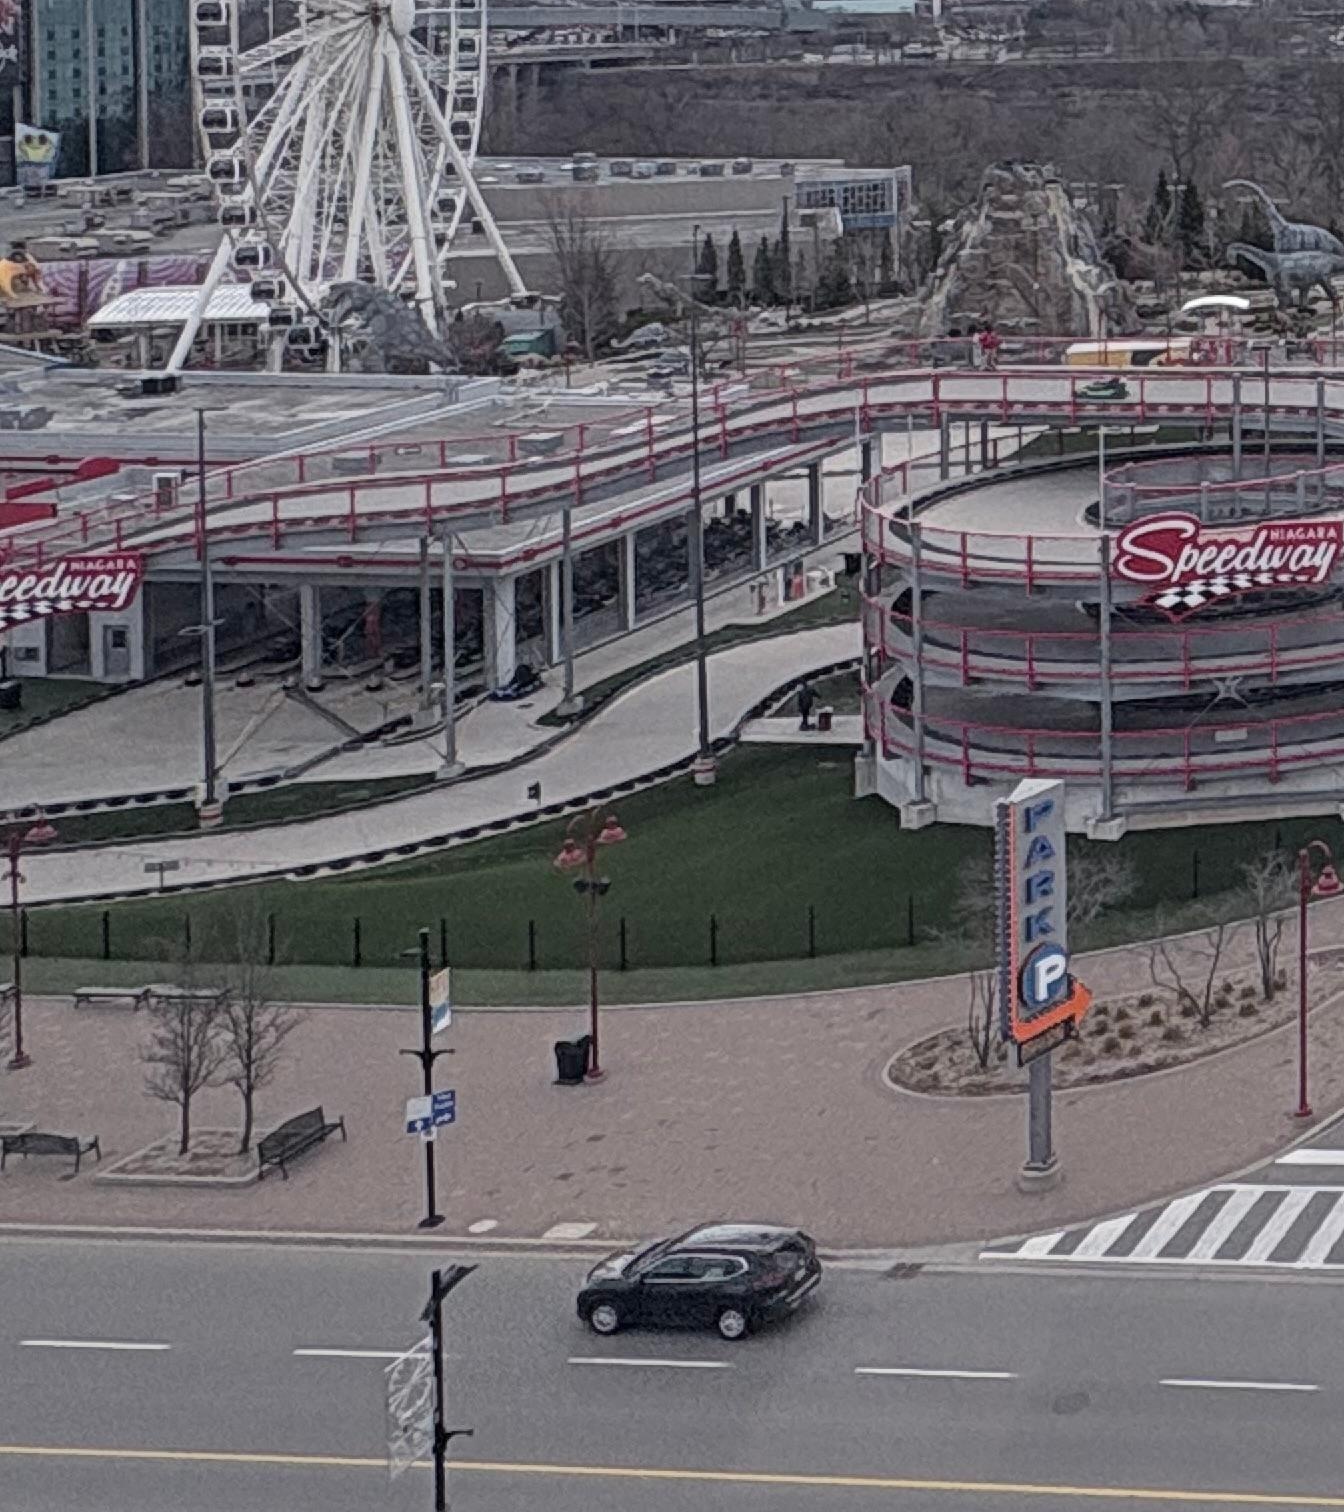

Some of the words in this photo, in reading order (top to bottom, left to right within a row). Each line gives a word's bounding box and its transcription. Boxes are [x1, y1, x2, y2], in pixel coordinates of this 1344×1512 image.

[1118, 519, 1339, 583] Speedway
[1270, 526, 1338, 541] NIAGARA
[1022, 799, 1056, 942] PARK
[1034, 953, 1066, 1002] P
